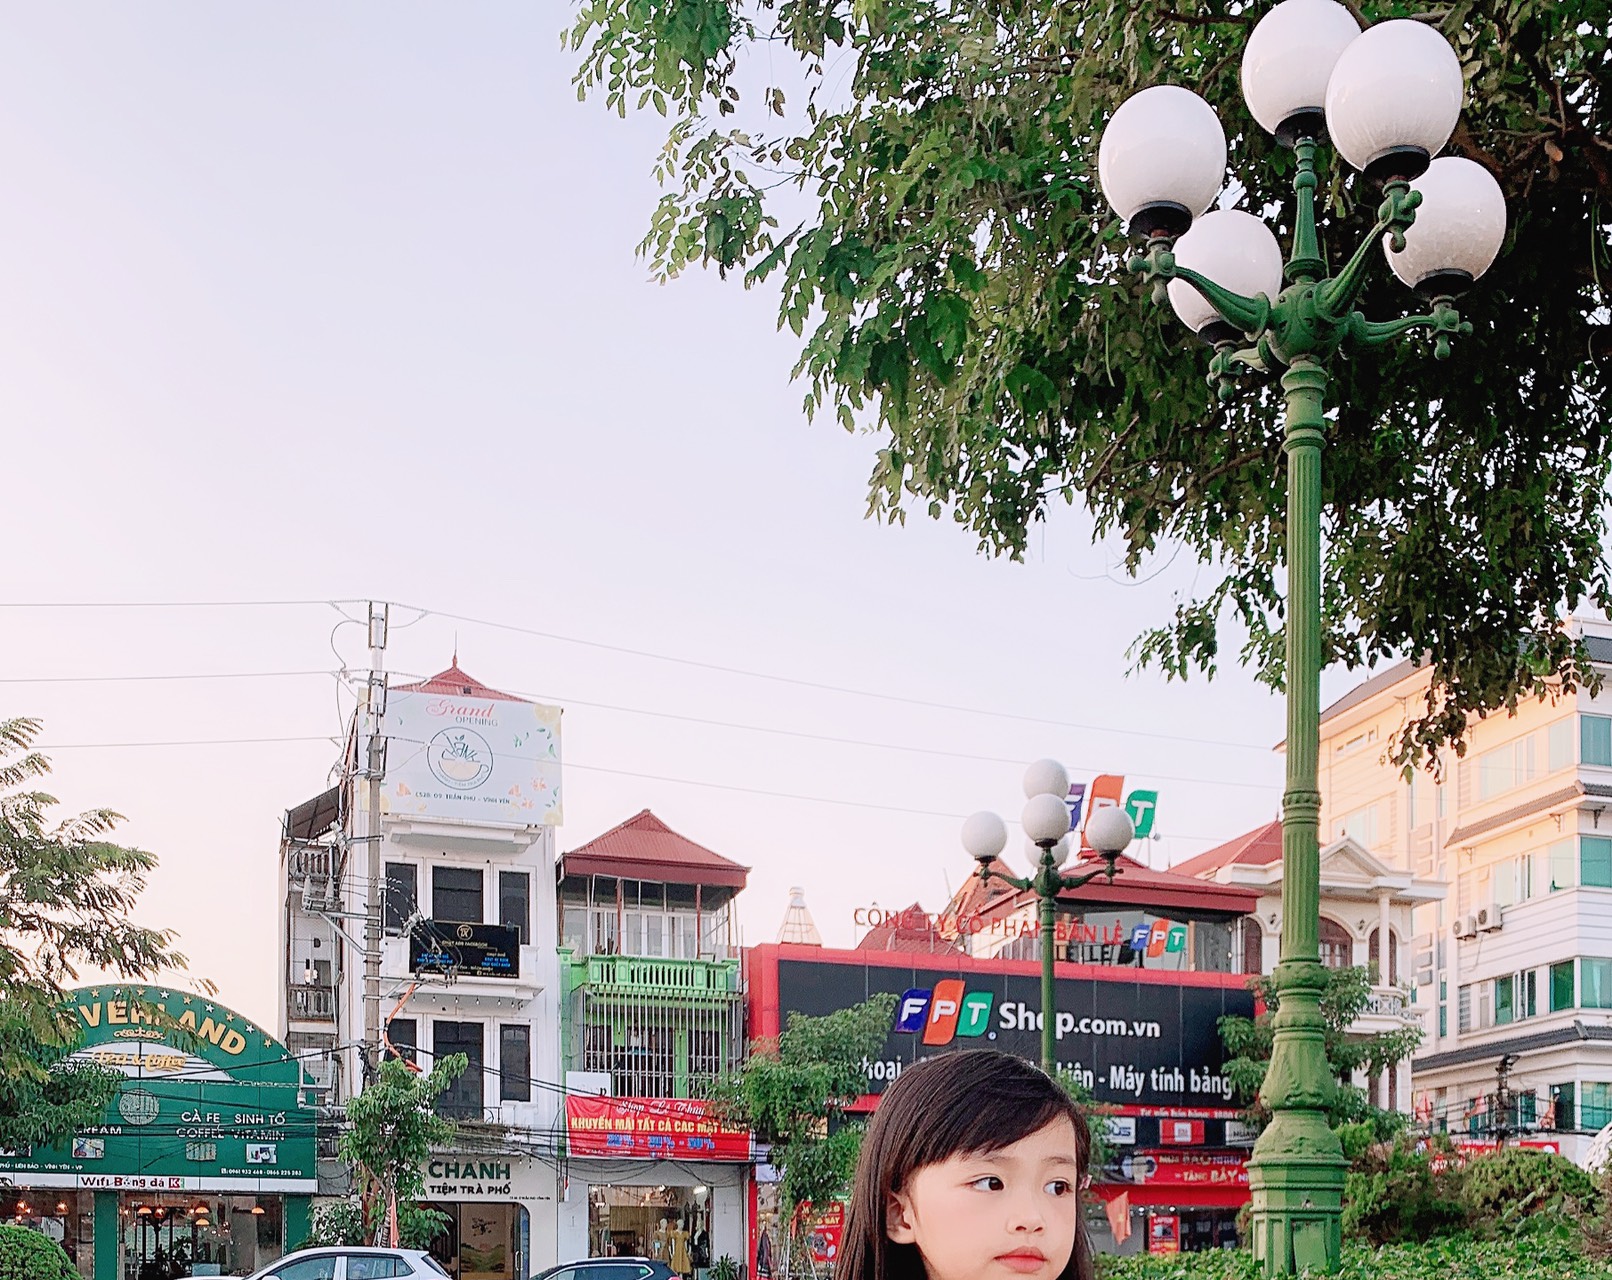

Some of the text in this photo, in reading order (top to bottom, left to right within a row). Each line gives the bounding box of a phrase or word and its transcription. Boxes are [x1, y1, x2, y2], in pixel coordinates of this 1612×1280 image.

[426, 699, 495, 717] Grand
[455, 716, 499, 727] OPENING
[144, 1053, 187, 1072] Coffee
[1109, 1064, 1145, 1098] Máy
[1150, 1066, 1185, 1093] tính
[1190, 1065, 1234, 1100] bảng
[181, 1108, 220, 1123] CÀ FE
[234, 1111, 286, 1125] SINH TỐ
[571, 1114, 613, 1130] KHUYẾN
[637, 1115, 656, 1131] TẤT
[176, 1127, 225, 1139] COFFEE
[231, 1128, 285, 1140] VITAMIN
[428, 1161, 511, 1180] CHANH
[81, 1176, 110, 1187] Wifi
[429, 1181, 512, 1195] TIỆM TRÀ PHỐ
